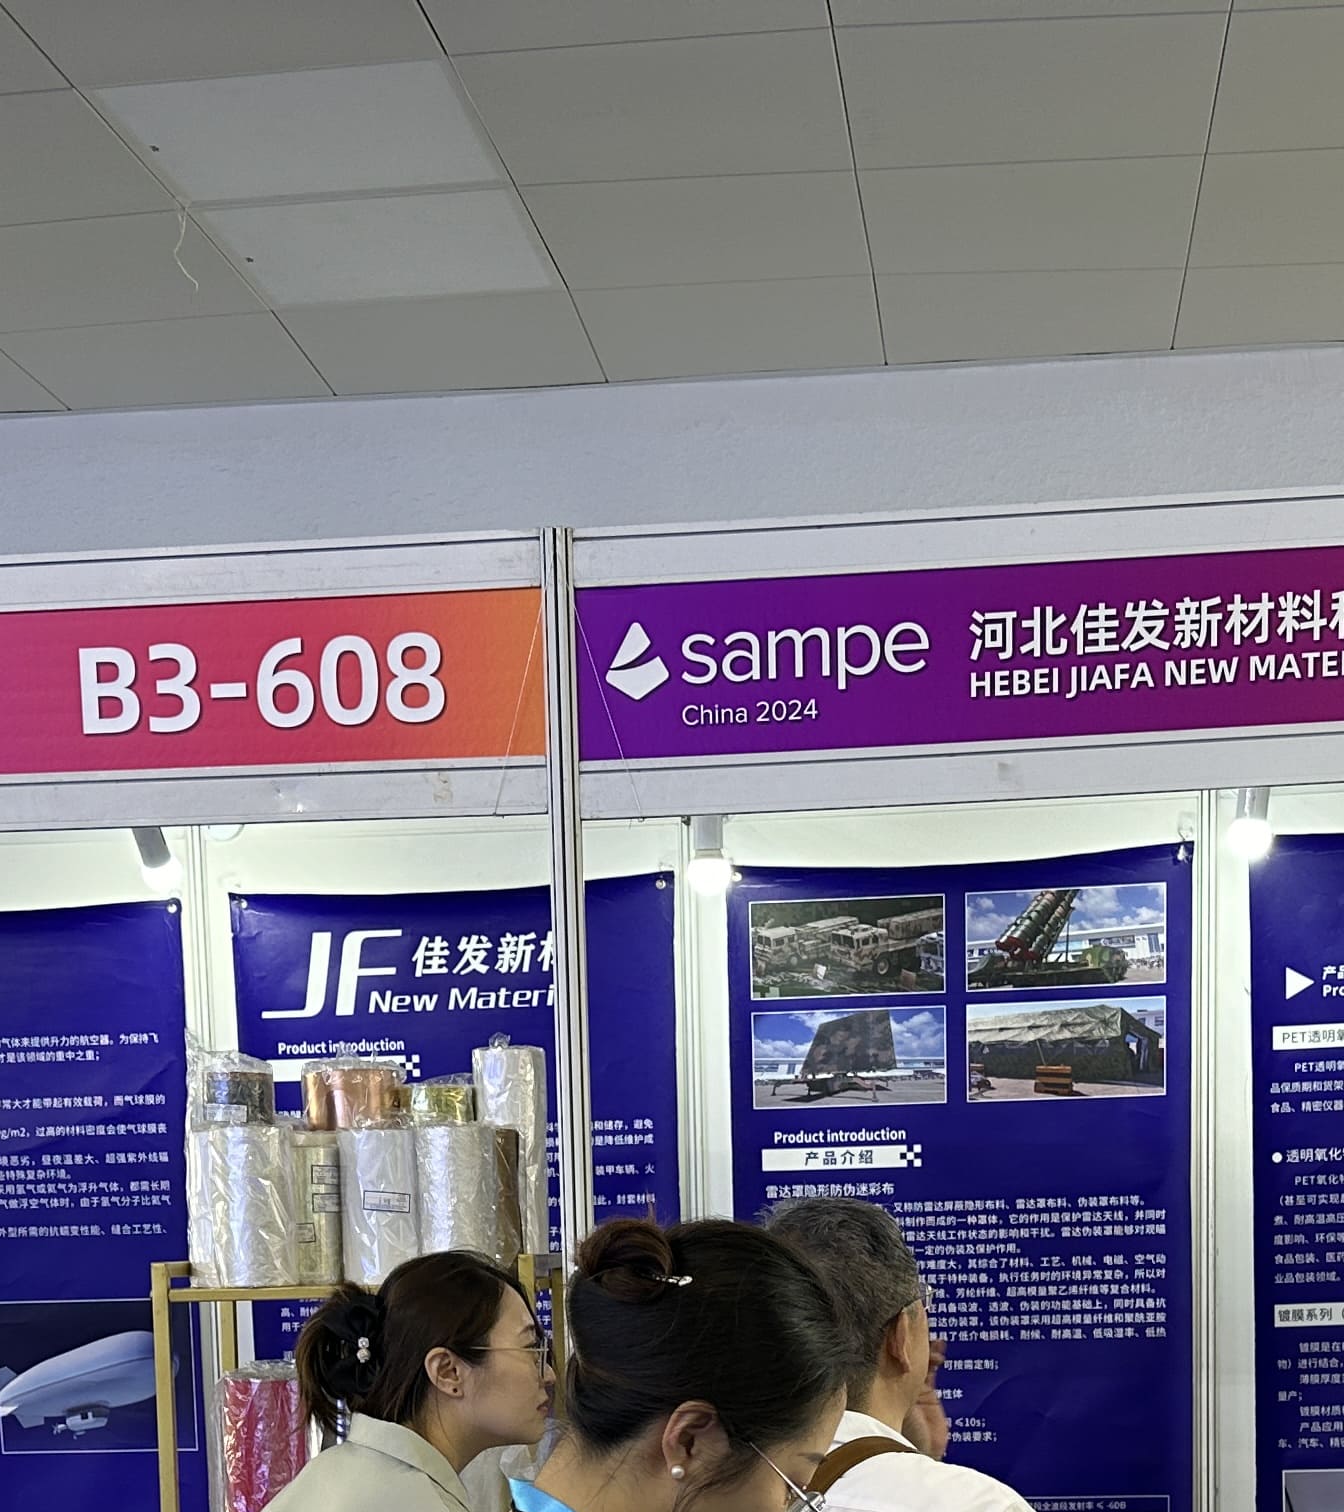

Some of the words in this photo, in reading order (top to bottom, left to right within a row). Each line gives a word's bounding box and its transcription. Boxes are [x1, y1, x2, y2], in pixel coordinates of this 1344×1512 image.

[681, 620, 930, 689] sampe
[78, 631, 446, 735] B3-608
[969, 670, 1060, 698] HEBEI
[1066, 663, 1154, 699] JIAFA
[1164, 658, 1236, 687] NEW
[682, 704, 748, 727] China
[756, 698, 818, 722] 2024
[261, 929, 403, 1019] JF
[368, 990, 437, 1014] New
[278, 1040, 326, 1055] Product
[329, 1038, 405, 1053] introduction
[774, 1129, 825, 1145] Product
[826, 1127, 906, 1142] introduction
[804, 1149, 873, 1166] 产品介绍
